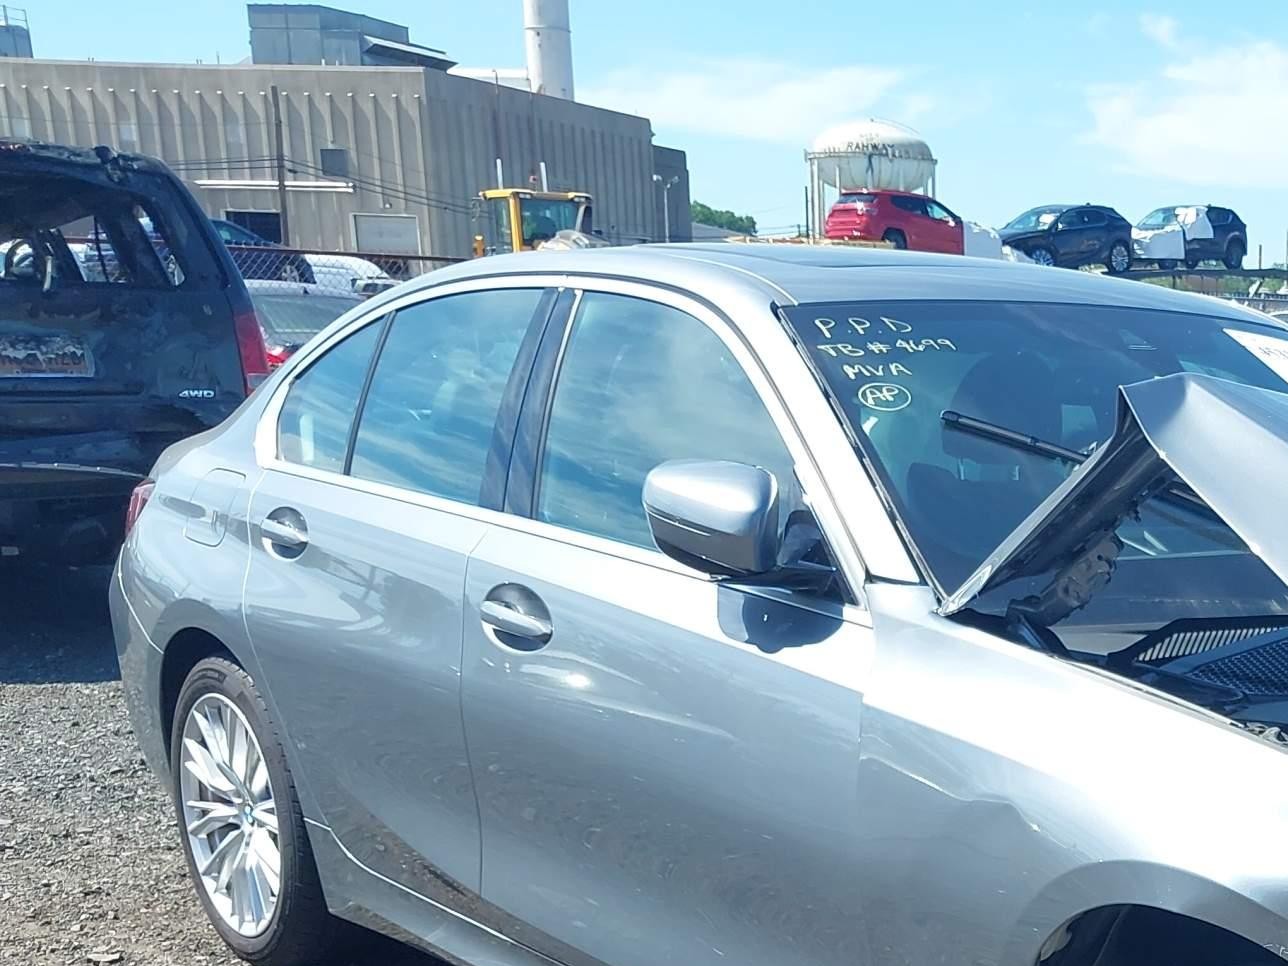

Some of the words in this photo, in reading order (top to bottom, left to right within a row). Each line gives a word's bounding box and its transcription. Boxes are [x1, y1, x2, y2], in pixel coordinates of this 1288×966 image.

[847, 142, 895, 153] RAHWAY
[842, 362, 912, 379] MVA
[178, 390, 215, 398] 4WD
